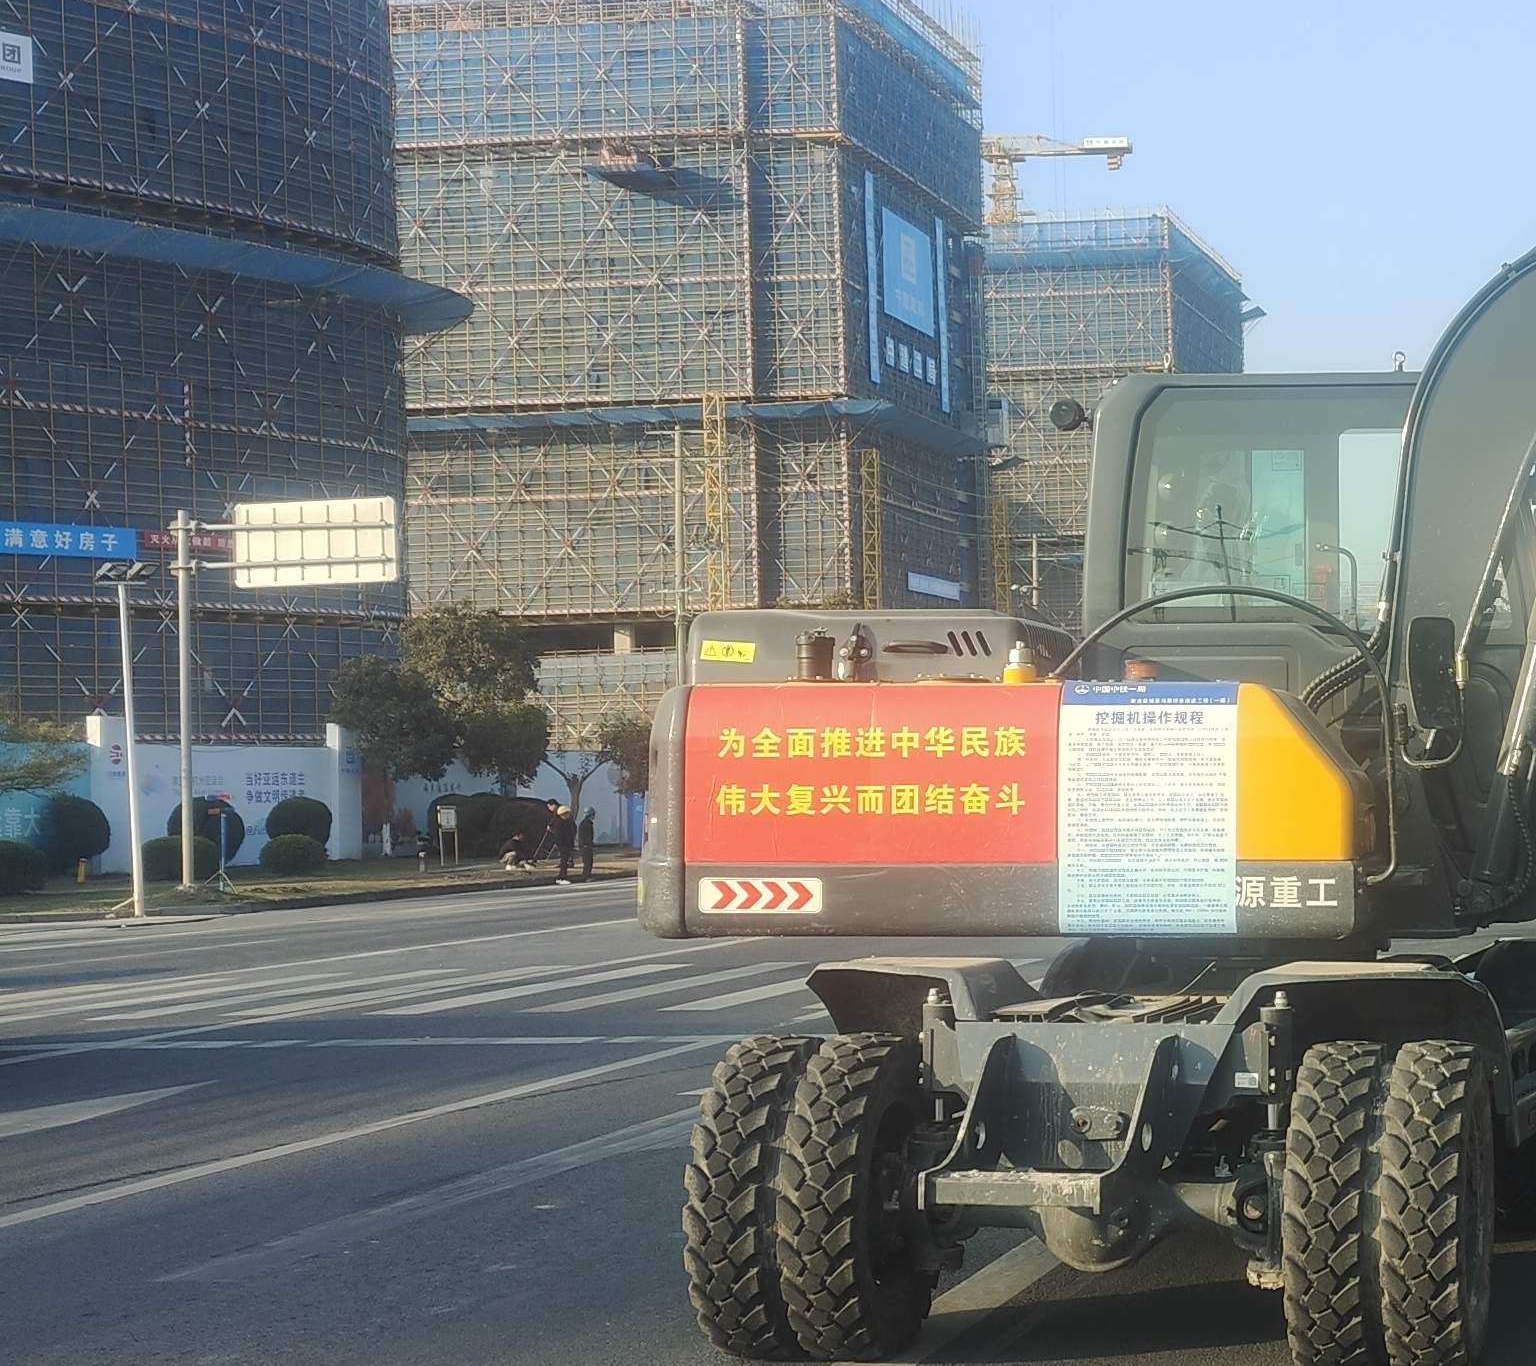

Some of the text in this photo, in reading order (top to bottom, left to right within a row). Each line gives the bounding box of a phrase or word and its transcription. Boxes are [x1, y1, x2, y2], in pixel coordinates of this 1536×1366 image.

[4, 527, 119, 552] 满意好房子
[1095, 710, 1205, 725] 挖掘机操作规程
[717, 725, 1026, 759] 为全面推进中华民族
[715, 782, 1026, 816] 伟大复兴而团结奋斗
